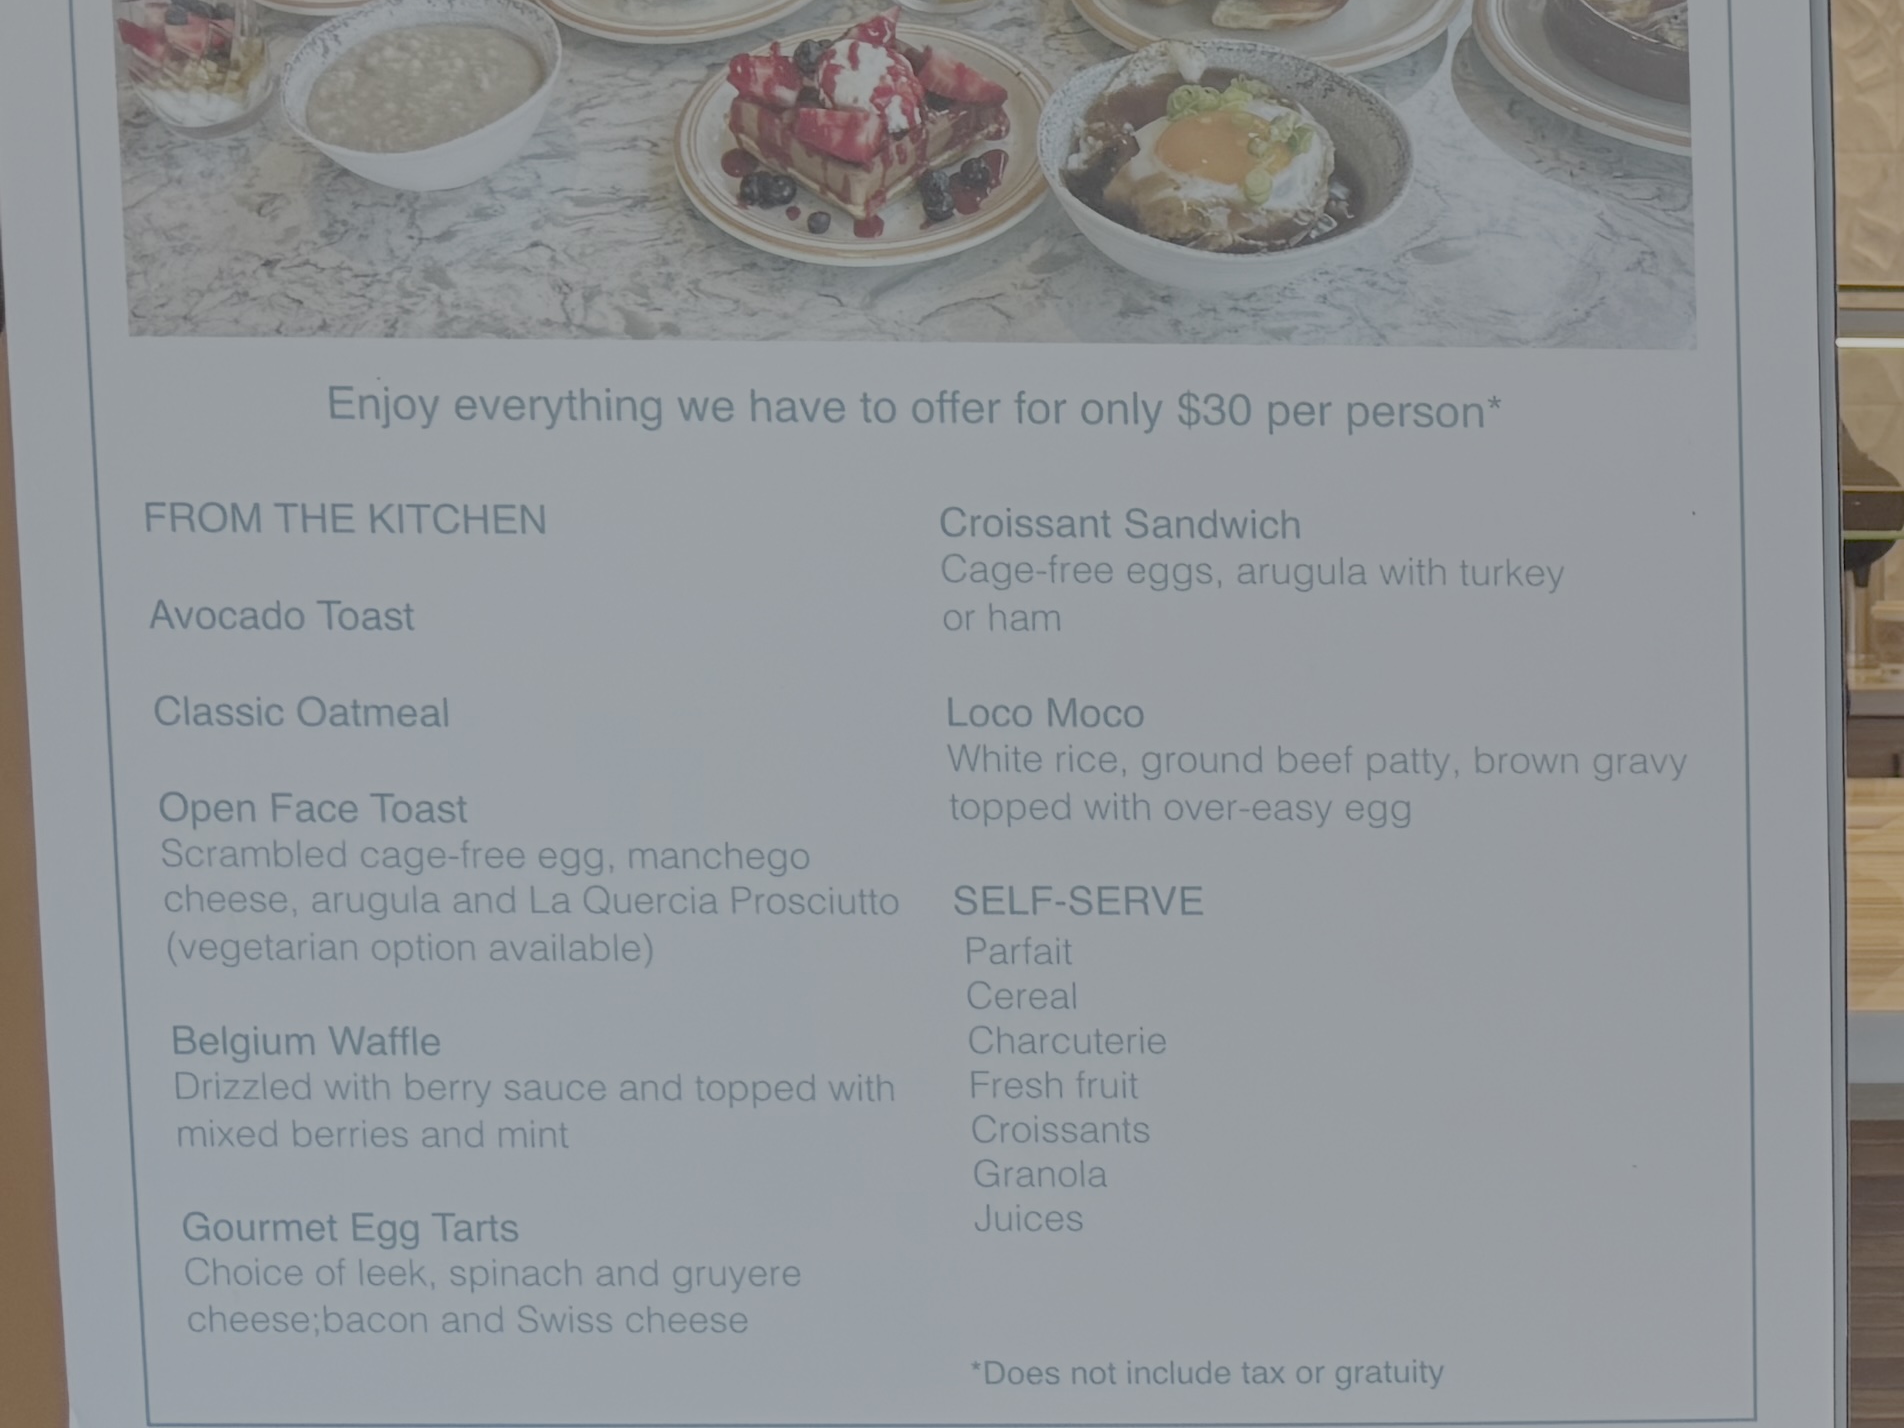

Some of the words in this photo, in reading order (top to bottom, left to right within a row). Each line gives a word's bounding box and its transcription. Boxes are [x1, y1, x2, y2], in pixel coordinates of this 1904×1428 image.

[328, 385, 440, 429] Enjoy
[454, 387, 662, 432] everything
[677, 397, 734, 423] we
[750, 388, 846, 424] have
[860, 392, 897, 424] to
[912, 389, 1001, 424] offer
[1014, 390, 1067, 425] for
[1081, 391, 1163, 434] only
[1178, 390, 1252, 429] $30
[1268, 401, 1332, 435] per
[145, 501, 262, 533] FROM
[273, 502, 355, 533] THE
[369, 503, 546, 535] KITCHEN
[940, 506, 1111, 538] Croissant
[1125, 507, 1301, 540] Sandwich
[941, 553, 1113, 591] Cage-free
[1127, 562, 1222, 592] eggs,
[1237, 557, 1367, 593] arugula
[1379, 557, 1446, 586] with
[1460, 558, 1564, 594] turkey
[149, 599, 305, 630] Avocado
[316, 600, 415, 631] Toast
[943, 609, 975, 631] or
[988, 603, 1061, 632] ham
[154, 695, 284, 727] Classic
[297, 695, 449, 728] Oatmeal
[947, 697, 1033, 728] Loco
[1047, 697, 1144, 728] Moco
[947, 743, 1042, 773] White
[1056, 744, 1126, 777] rice,
[1141, 745, 1263, 781] ground
[1277, 744, 1352, 774] beef
[1366, 748, 1459, 781] patty,
[1474, 746, 1579, 774] brown
[1593, 753, 1687, 782] gravy
[159, 791, 256, 830] Open
[271, 792, 358, 823] Face
[370, 792, 468, 824] Toast
[949, 792, 1071, 828] topped
[1084, 792, 1151, 821] with
[1164, 799, 1332, 828] over-easy
[1345, 800, 1411, 829] egg
[161, 837, 347, 868] Scrambled
[360, 839, 526, 876] cage-free
[538, 847, 614, 877] egg,
[628, 841, 810, 878] manchego
[164, 884, 297, 917] cheese,
[312, 885, 441, 921] arugula
[453, 885, 516, 914] and
[530, 885, 572, 914] La
[583, 884, 719, 915] Quercia
[731, 886, 900, 916] Prosciutto
[954, 885, 1203, 916] SELF-SERVE
[167, 931, 358, 968] (vegetarian
[371, 933, 476, 968] option
[489, 933, 653, 968] available)
[966, 936, 1072, 965] Parfait
[967, 980, 1077, 1010] Cereal
[172, 1025, 315, 1064] Belgium
[328, 1026, 441, 1056] Waffle
[968, 1025, 1166, 1055] Charcuterie
[175, 1071, 312, 1101] Drizzled
[324, 1072, 391, 1101] with
[404, 1072, 491, 1108] berry
[504, 1079, 607, 1102] sauce
[619, 1073, 682, 1101] and
[695, 1074, 816, 1109] topped
[828, 1073, 895, 1102] with
[970, 1070, 1063, 1099] Fresh
[1076, 1070, 1139, 1100] fruit
[177, 1119, 278, 1148] mixed
[292, 1119, 409, 1148] berries
[421, 1120, 484, 1148] and
[498, 1120, 569, 1149] mint
[971, 1114, 1150, 1144] Croissants
[973, 1158, 1108, 1188] Granola
[182, 1211, 338, 1242] Gourmet
[352, 1212, 420, 1250] Egg
[431, 1212, 519, 1243] Tarts
[974, 1204, 1084, 1232] Juices
[184, 1257, 303, 1287] Choice
[315, 1257, 346, 1287] of
[358, 1258, 435, 1290] leek,
[450, 1259, 583, 1294] spinach
[596, 1259, 659, 1287] and
[672, 1265, 801, 1294] gruyere
[442, 1305, 504, 1334] and
[517, 1304, 613, 1334] Swiss
[625, 1306, 748, 1334] cheese
[1071, 1362, 1117, 1385] not
[1127, 1360, 1231, 1385] include
[1241, 1362, 1285, 1385] tax
[1296, 1365, 1325, 1385] or
[1335, 1359, 1444, 1391] gratuity
